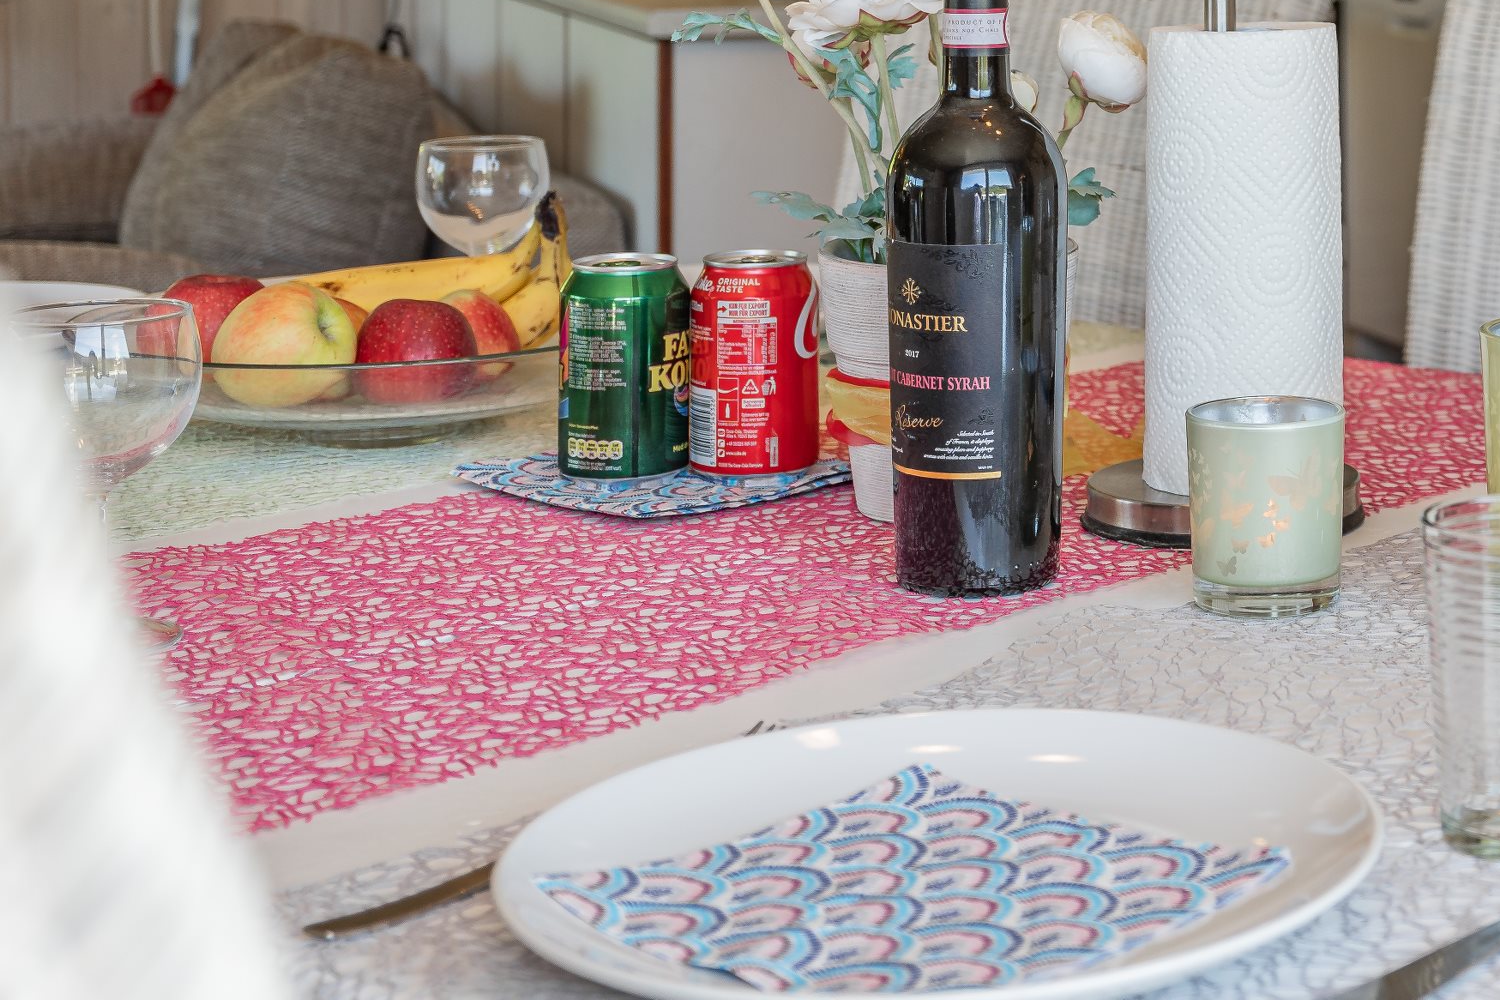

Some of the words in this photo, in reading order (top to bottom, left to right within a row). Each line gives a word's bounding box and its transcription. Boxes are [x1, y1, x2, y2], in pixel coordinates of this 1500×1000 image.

[717, 277, 760, 286] ORIGINAL
[716, 285, 744, 293] TASTE
[663, 330, 690, 361] FA
[905, 349, 920, 358] 2017
[897, 370, 945, 390] CABERNET
[947, 376, 991, 391] SYRAH
